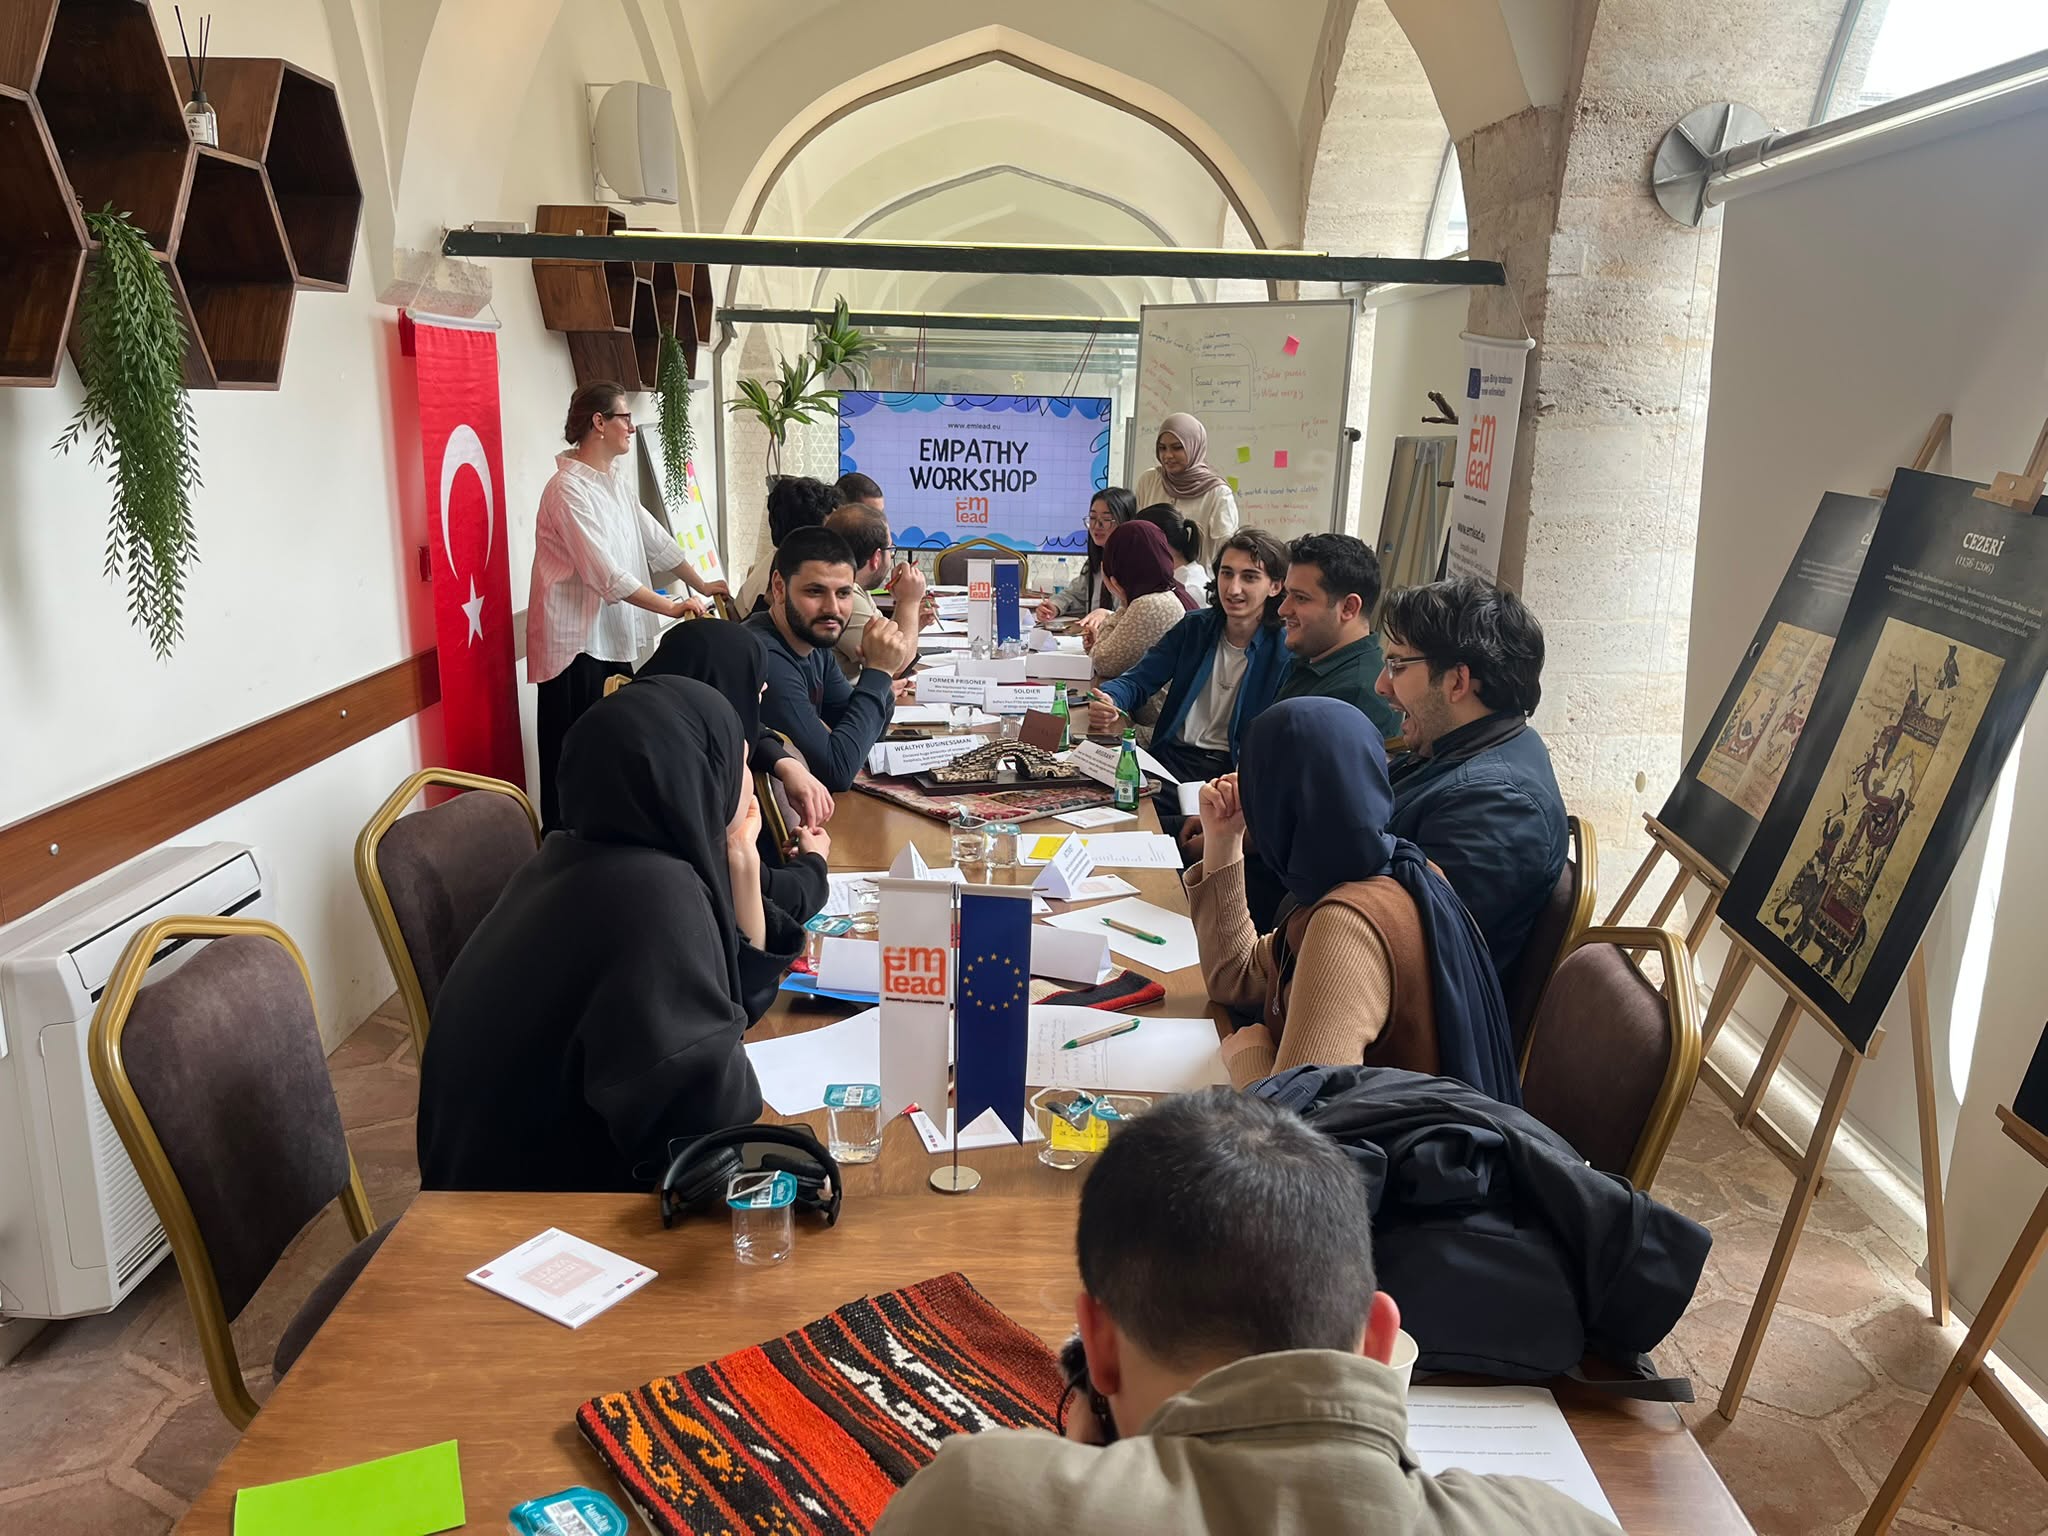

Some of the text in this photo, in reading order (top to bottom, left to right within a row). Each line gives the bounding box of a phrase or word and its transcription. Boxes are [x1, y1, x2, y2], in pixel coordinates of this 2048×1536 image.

[947, 421, 1001, 431] www.emlead.eu
[919, 438, 1029, 465] EMPATHY
[909, 466, 1037, 493] WORKSHOP
[956, 511, 988, 523] lead
[894, 738, 972, 752] WEALTHY BUSINESSMAN
[885, 974, 946, 996] lead
